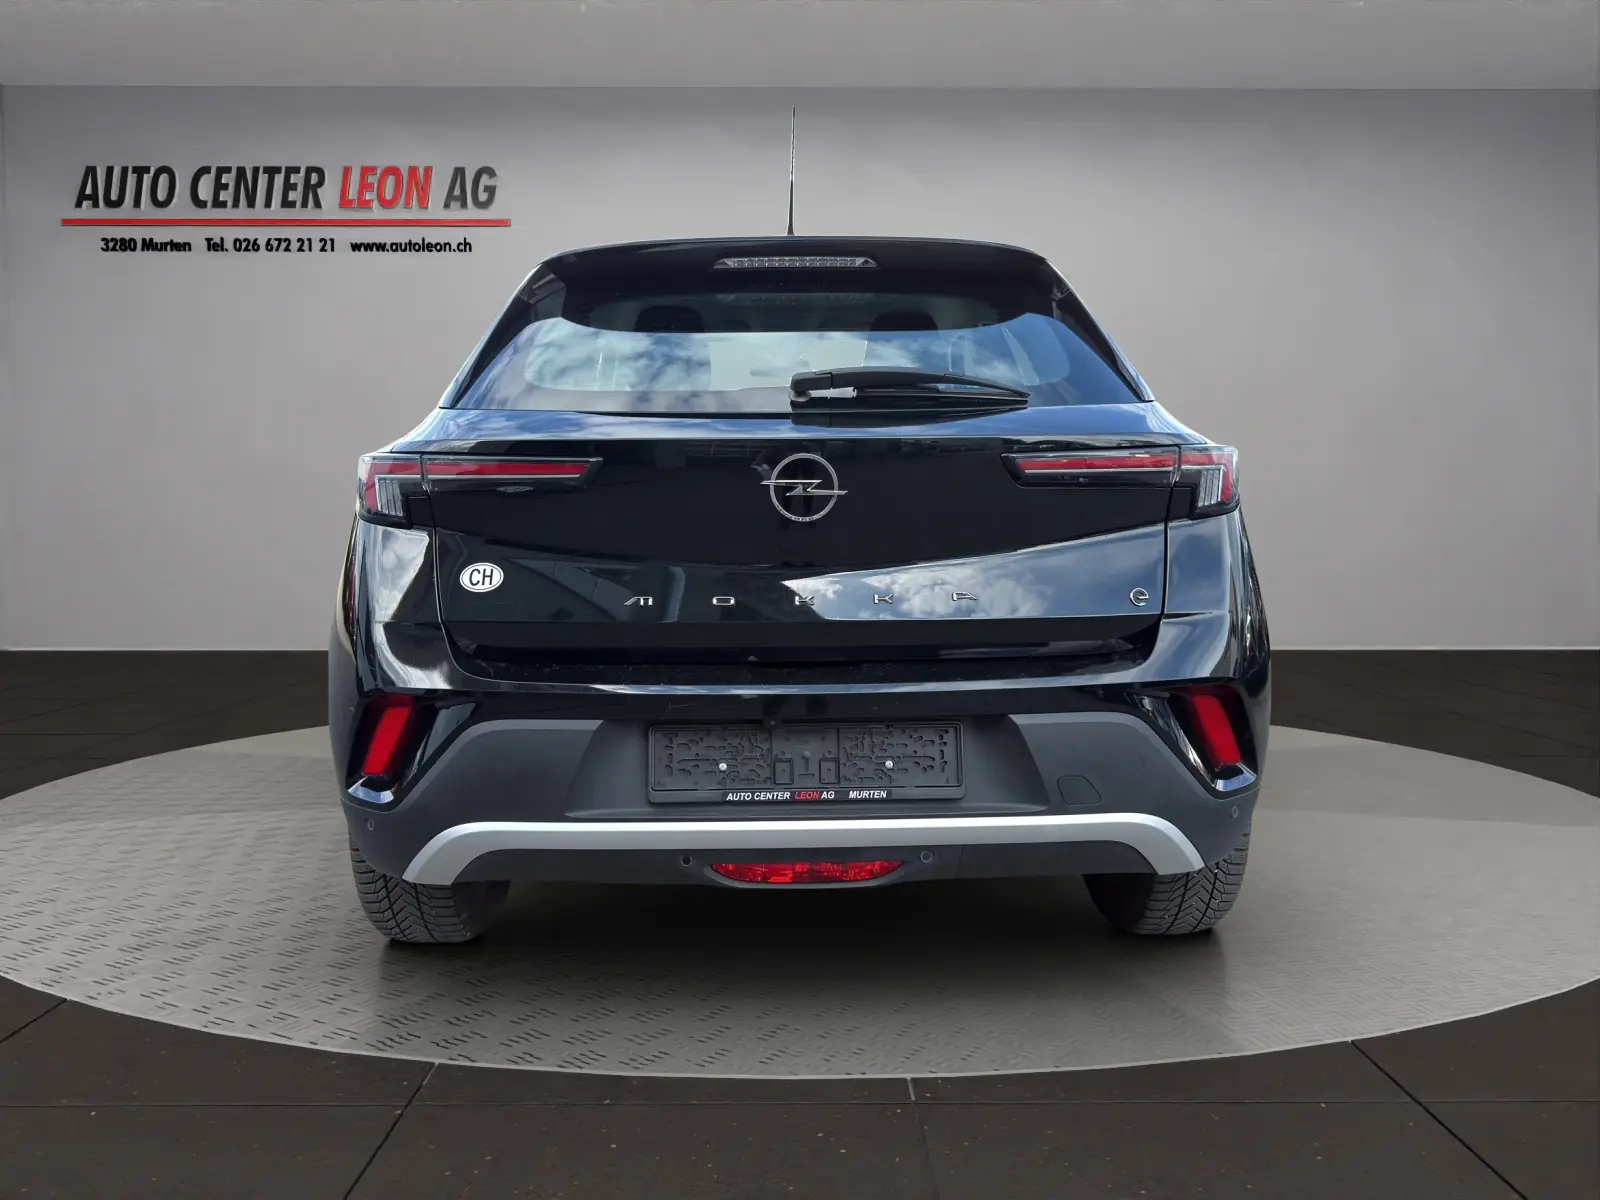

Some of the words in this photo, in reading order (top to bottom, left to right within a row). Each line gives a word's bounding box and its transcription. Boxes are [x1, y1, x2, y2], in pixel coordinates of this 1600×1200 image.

[74, 165, 178, 209] AUTO
[190, 165, 326, 209] CENTER
[338, 165, 434, 210] LEON
[443, 165, 499, 210] AG
[100, 237, 137, 252] 3280
[141, 237, 192, 252] Murten
[205, 236, 228, 252] Tel.
[233, 237, 260, 252] 026
[265, 237, 292, 252] 672
[297, 237, 313, 252] 21
[319, 237, 335, 252] 21
[350, 236, 473, 253] www.autoleon.ch
[469, 568, 494, 586] CH
[726, 792, 751, 801] AUTO
[754, 791, 791, 800] CENTER
[795, 791, 820, 800] LEON
[821, 791, 835, 799] AG
[848, 790, 887, 799] MURTEN
